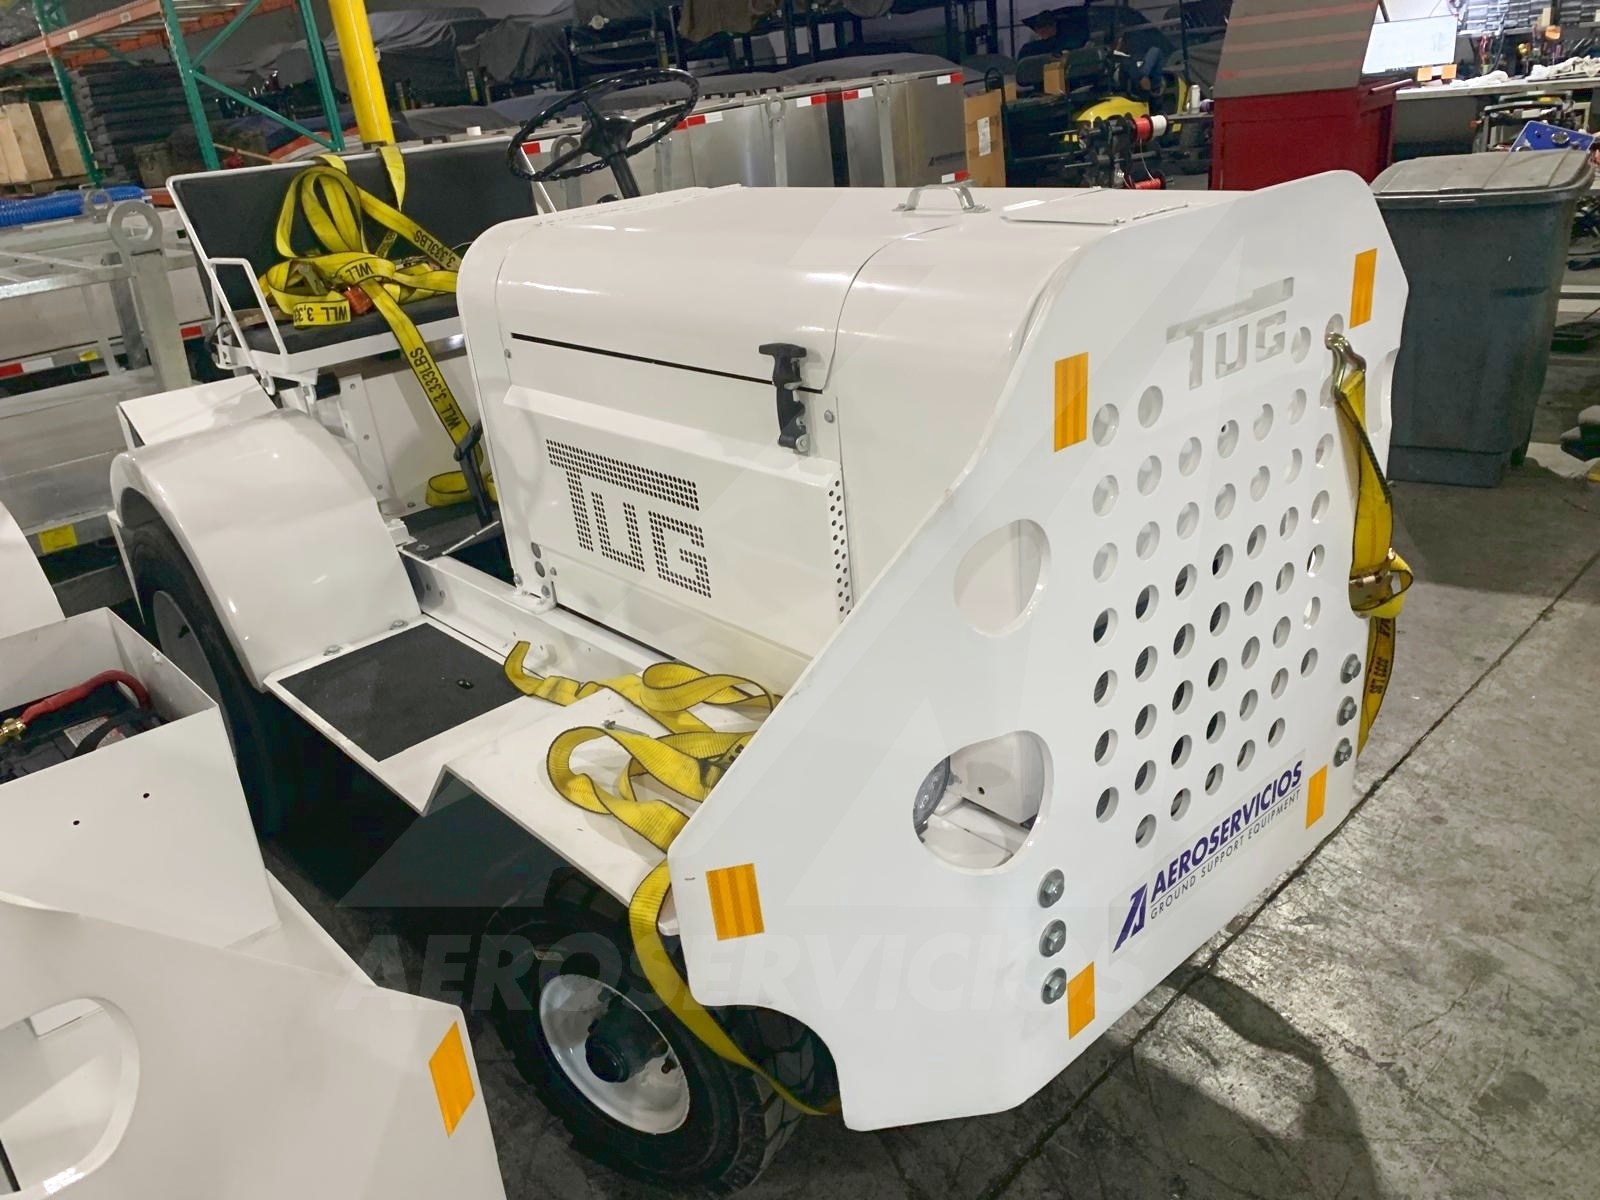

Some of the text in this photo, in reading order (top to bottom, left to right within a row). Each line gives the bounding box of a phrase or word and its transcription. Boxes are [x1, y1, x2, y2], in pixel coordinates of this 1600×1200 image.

[320, 306, 347, 322] WLL
[345, 262, 374, 282] WLL
[1166, 276, 1294, 391] TUG
[441, 403, 461, 430] WLL
[546, 439, 711, 599] TUG
[1151, 760, 1303, 903] AEROSERVICIOS
[1151, 789, 1301, 919] GROUND SUPPORT EQUIPMENT
